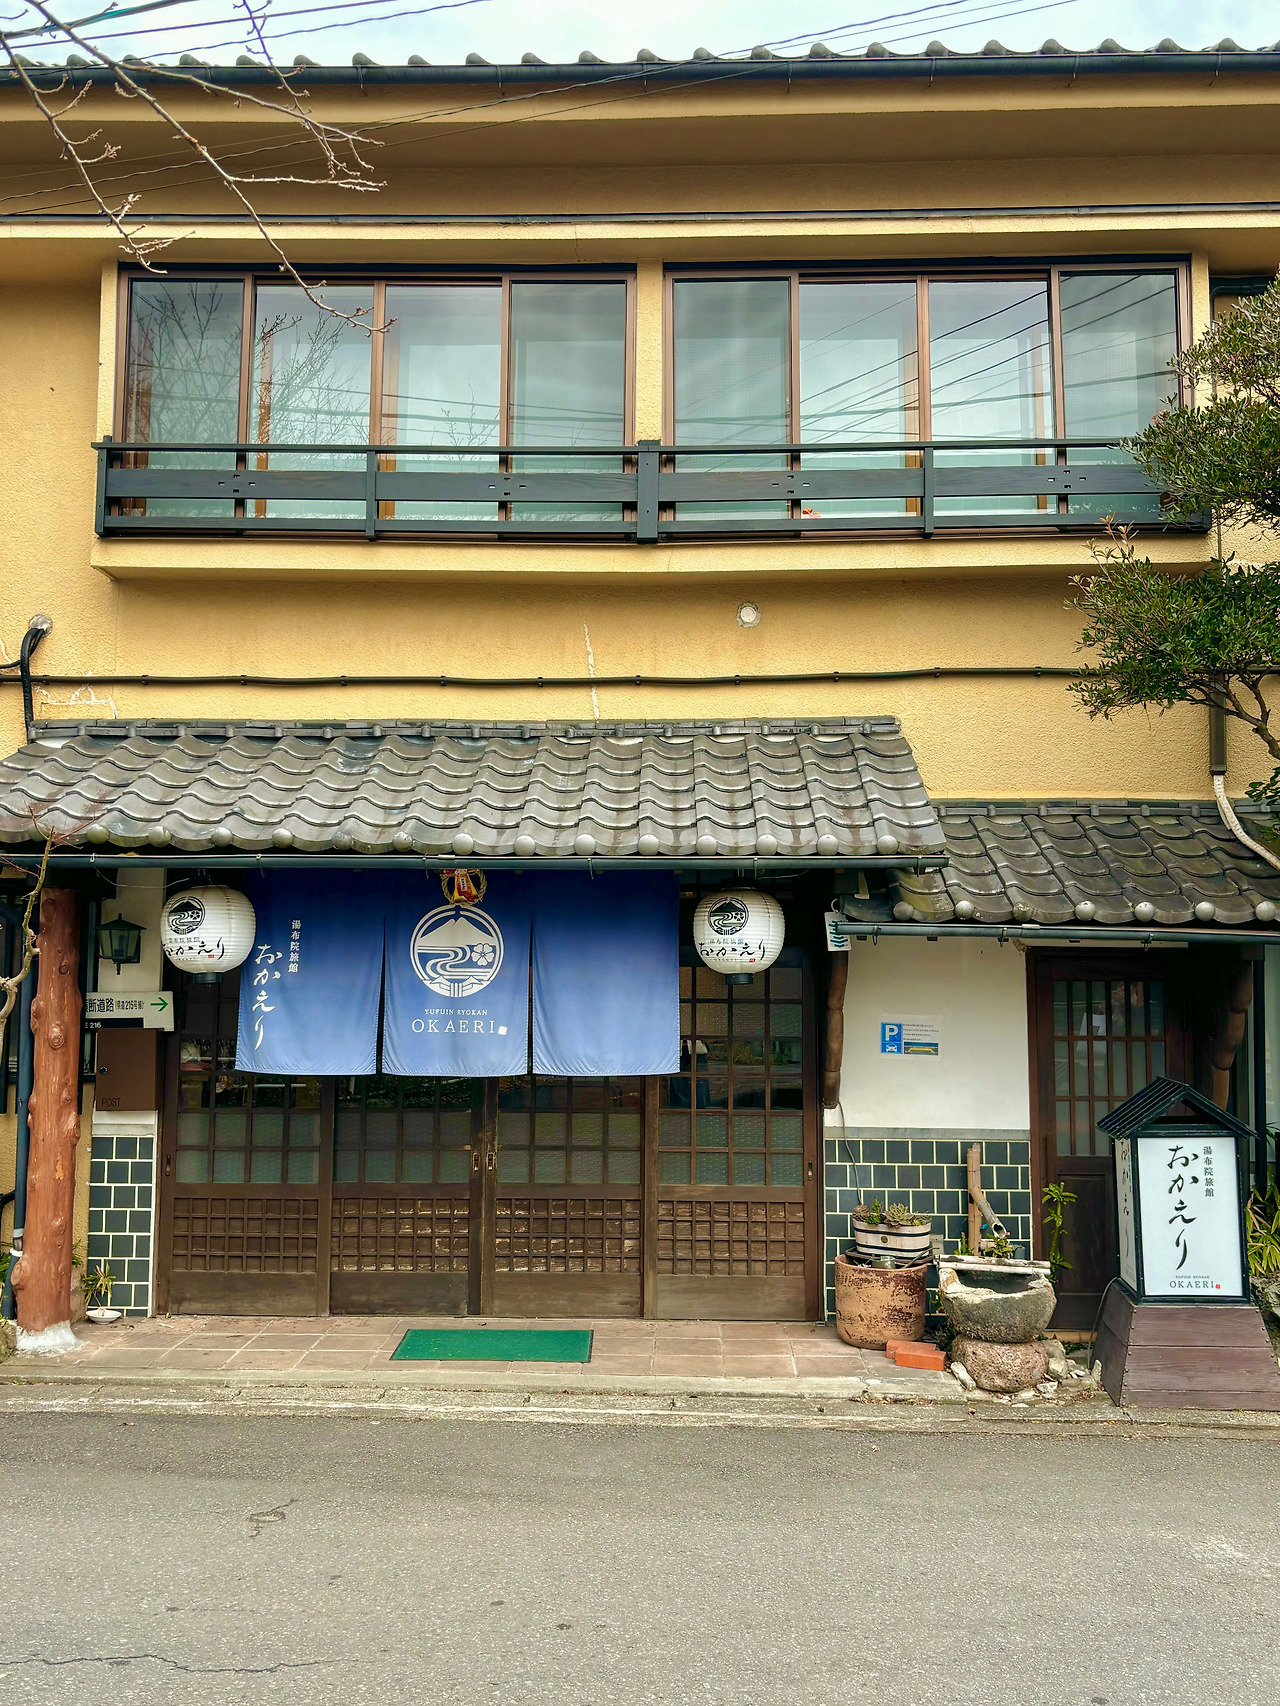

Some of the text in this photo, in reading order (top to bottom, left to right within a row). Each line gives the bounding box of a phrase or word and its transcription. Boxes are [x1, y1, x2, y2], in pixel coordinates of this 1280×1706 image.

[288, 919, 302, 973] 湯布院旅館
[698, 938, 766, 961] おかえり
[252, 943, 283, 1051] おかえり
[411, 1019, 495, 1034] OKAERI
[101, 1098, 122, 1107] POST
[1203, 1145, 1215, 1198] 湯布院旅館
[1166, 1145, 1200, 1271] おかえり
[1169, 1280, 1215, 1289] OKAERI
